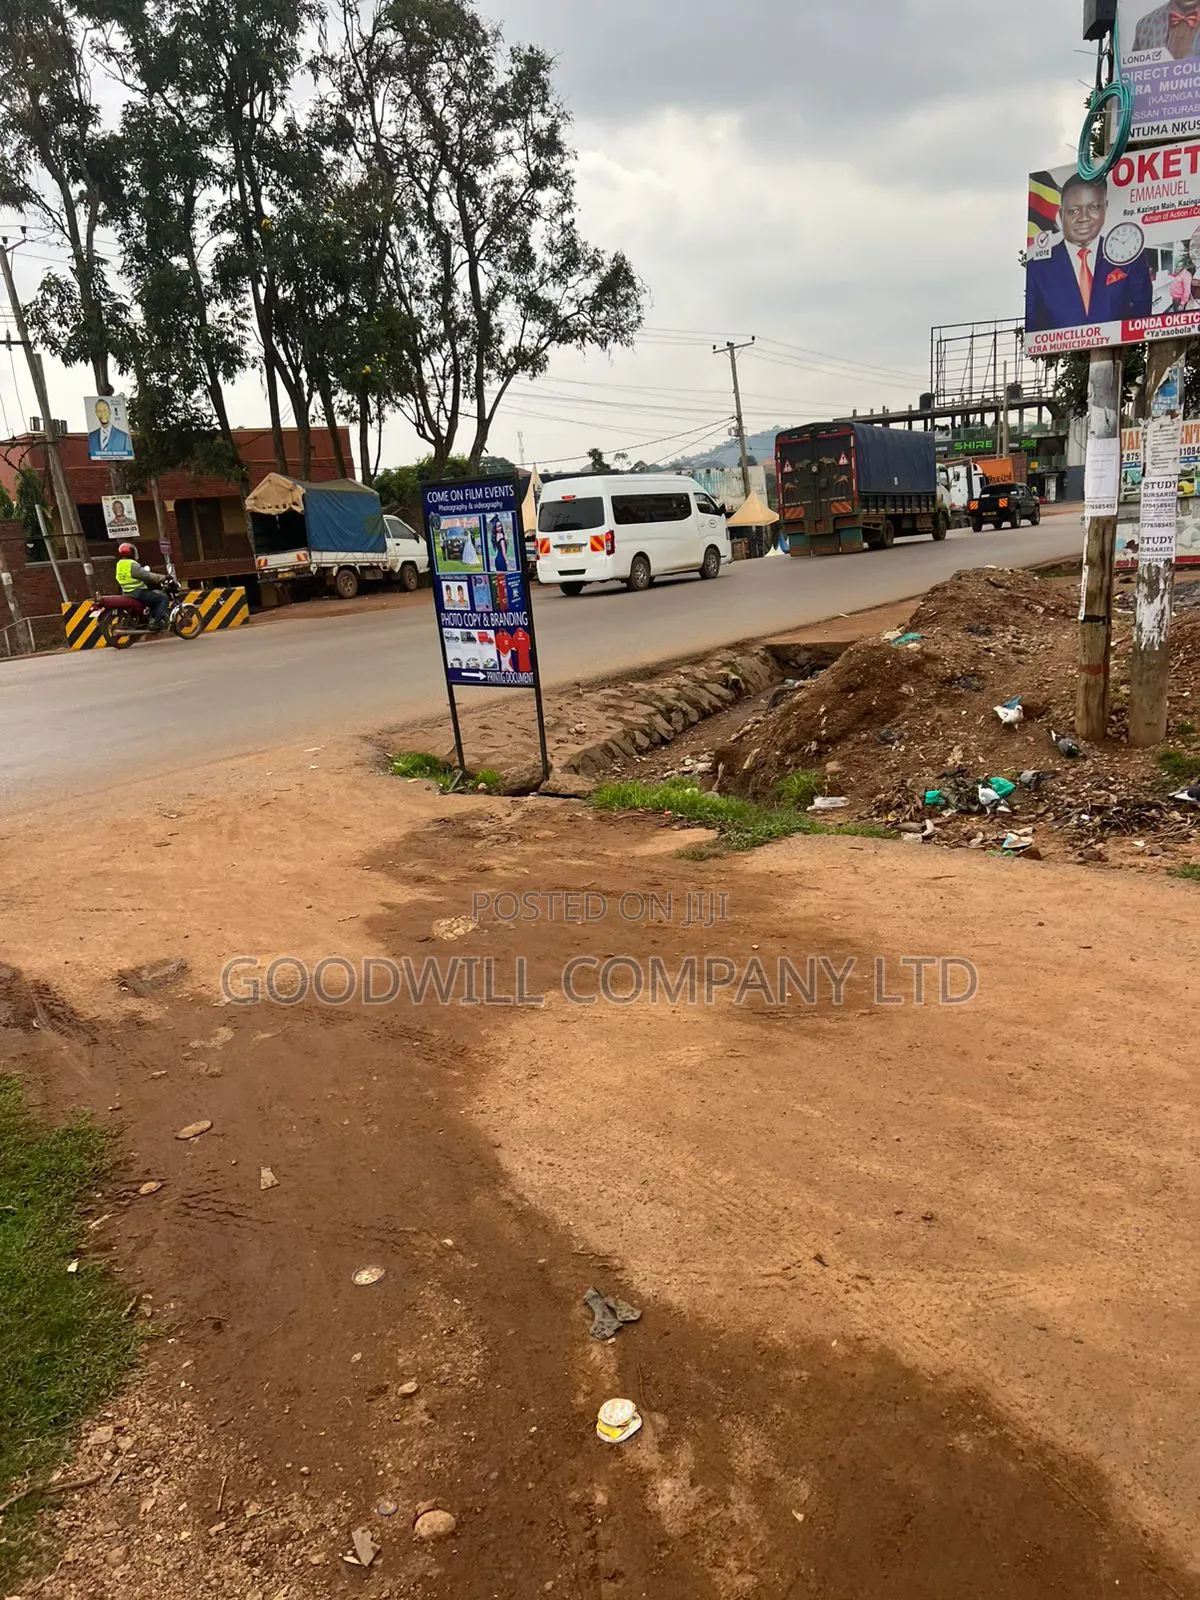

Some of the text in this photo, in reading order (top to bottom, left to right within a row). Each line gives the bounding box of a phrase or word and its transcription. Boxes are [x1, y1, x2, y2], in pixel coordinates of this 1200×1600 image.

[1122, 54, 1151, 65] LONDA
[1121, 66, 1170, 84] DIRECT
[1148, 91, 1193, 107] (KAZINGA
[1112, 144, 1200, 187] OKET
[1129, 180, 1189, 204] EMMANUEL
[1136, 204, 1160, 215] Kazinga
[1170, 211, 1188, 219] Action
[1034, 249, 1050, 258] VOTE
[1128, 317, 1162, 331] LONDA
[1034, 326, 1101, 344] COUNCILLOR
[1027, 336, 1110, 354] KIRA MUNICIPALITY
[954, 440, 993, 451] SHIRE
[1143, 480, 1177, 490] STUDY
[427, 484, 515, 503] COME ON FILM EVENTS
[438, 501, 504, 513] Photography & videography
[1140, 535, 1174, 545] STUDY
[441, 611, 529, 627] PHOTO COPY & BRANDING
